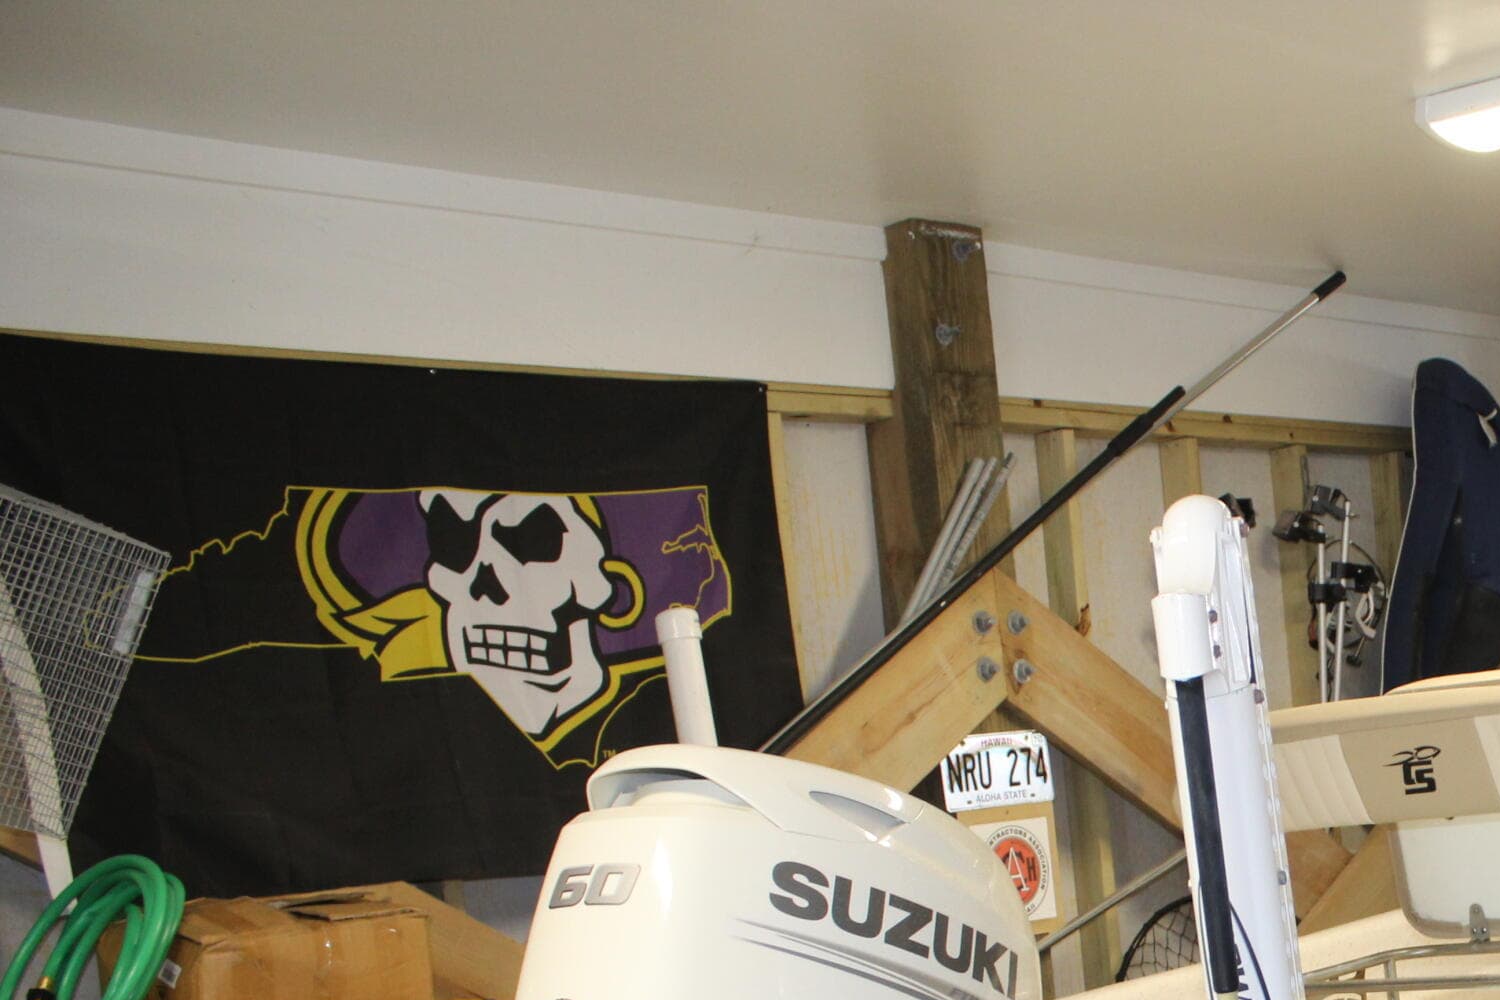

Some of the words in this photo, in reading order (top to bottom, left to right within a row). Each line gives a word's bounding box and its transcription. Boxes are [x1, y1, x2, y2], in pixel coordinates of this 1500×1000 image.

[946, 751, 992, 793] NRU
[1006, 746, 1047, 787] 274
[976, 793, 1002, 803] ALOHA
[1003, 789, 1028, 800] STATE
[988, 828, 1028, 846] NTRACTORS
[548, 863, 642, 910] 60
